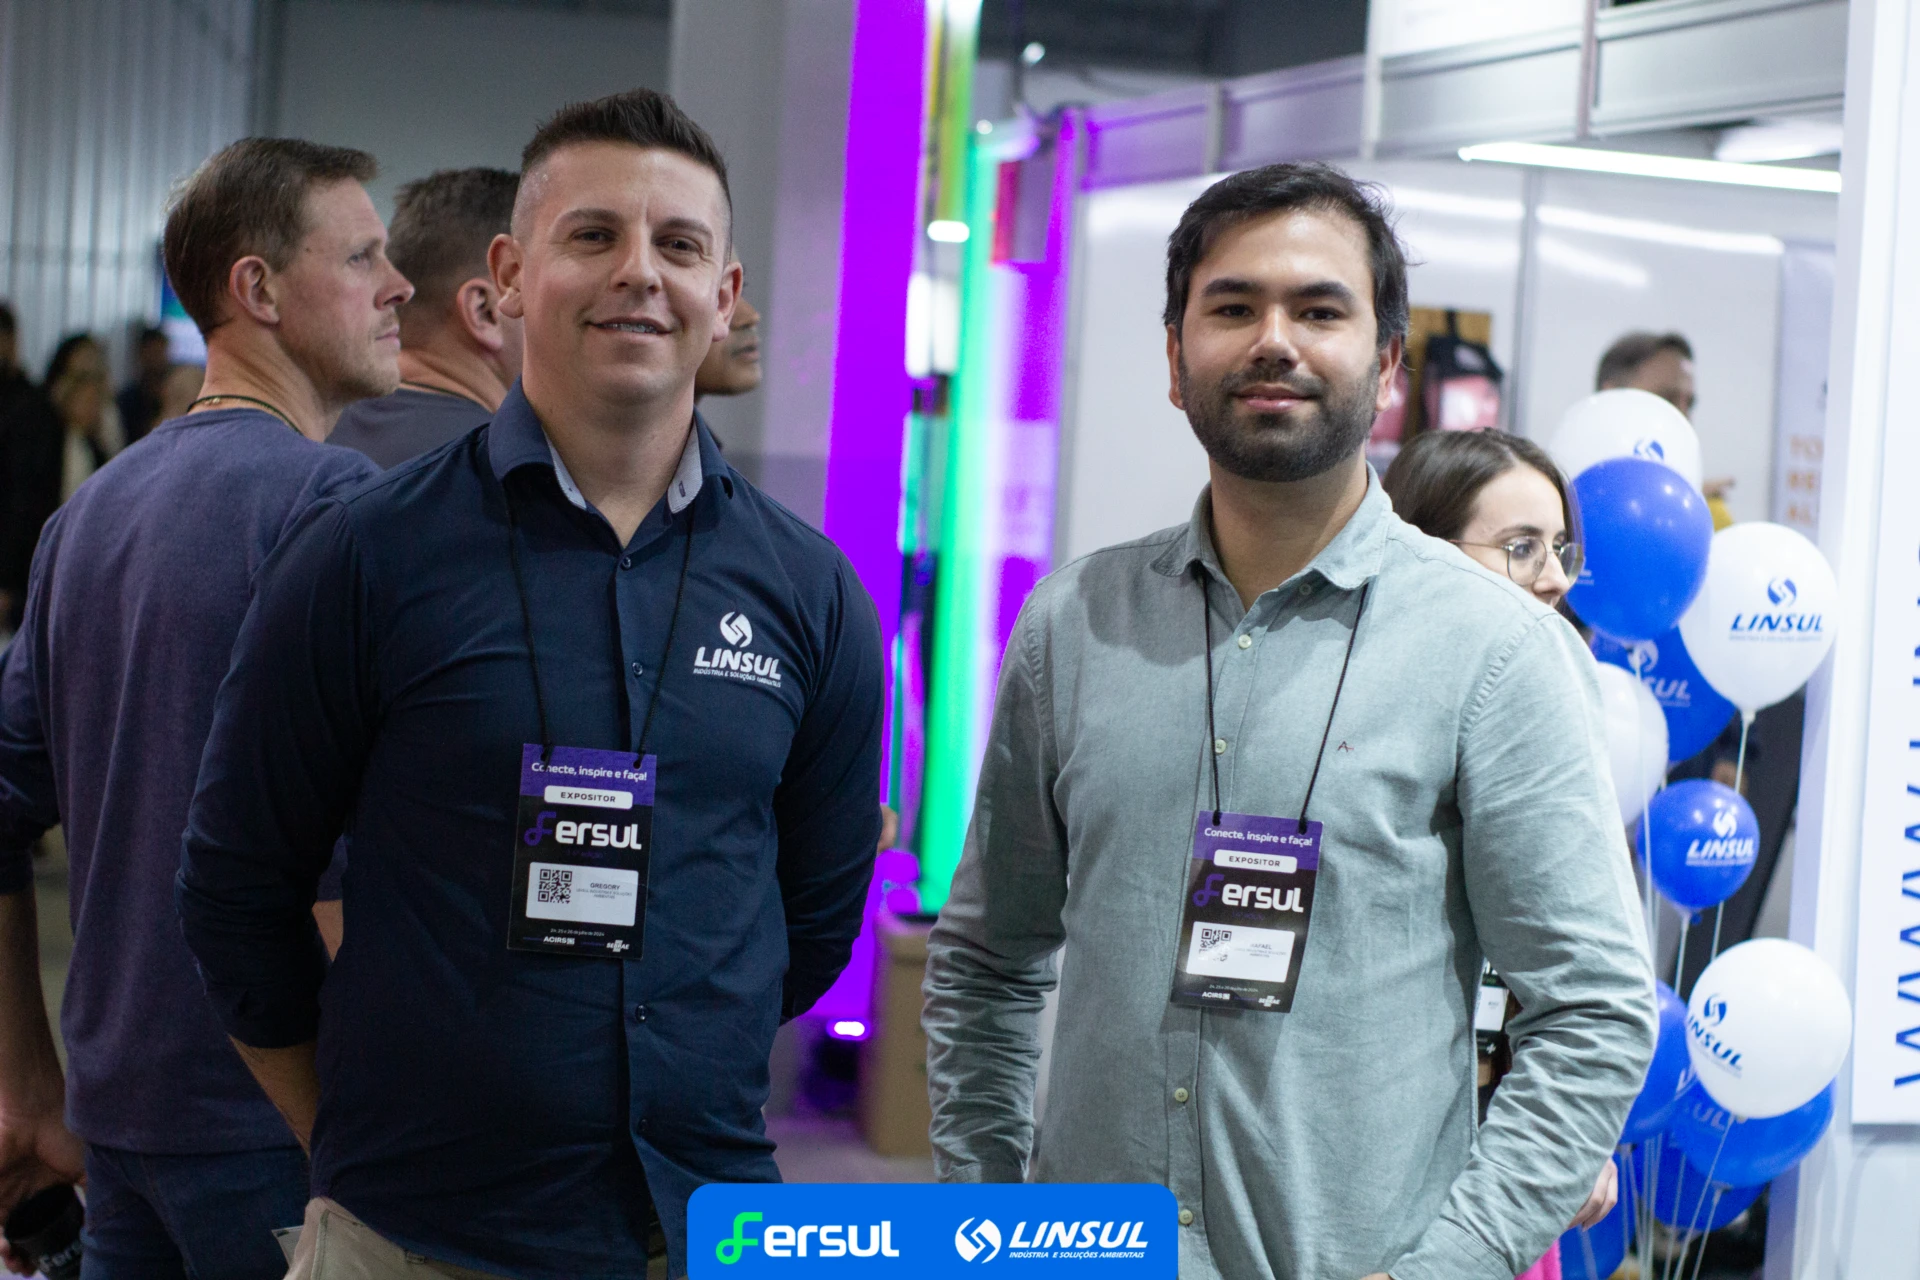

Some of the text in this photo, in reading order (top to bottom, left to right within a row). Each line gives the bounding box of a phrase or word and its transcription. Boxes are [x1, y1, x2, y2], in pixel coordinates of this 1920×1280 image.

[1731, 613, 1823, 632] LINSUL
[694, 646, 782, 681] LINSUL
[531, 762, 577, 775] Conecte,
[578, 765, 613, 779] inspire
[623, 770, 647, 782] faça!
[560, 791, 616, 803] EXPOSITOR
[1204, 827, 1245, 841] Conecte,
[1246, 831, 1279, 844] inspire
[1288, 835, 1313, 848] faça!
[1687, 837, 1754, 859] LINSUL
[1228, 855, 1281, 867] EXPOSITOR
[590, 882, 621, 890] GREGORY
[1688, 1015, 1743, 1071] INSUL
